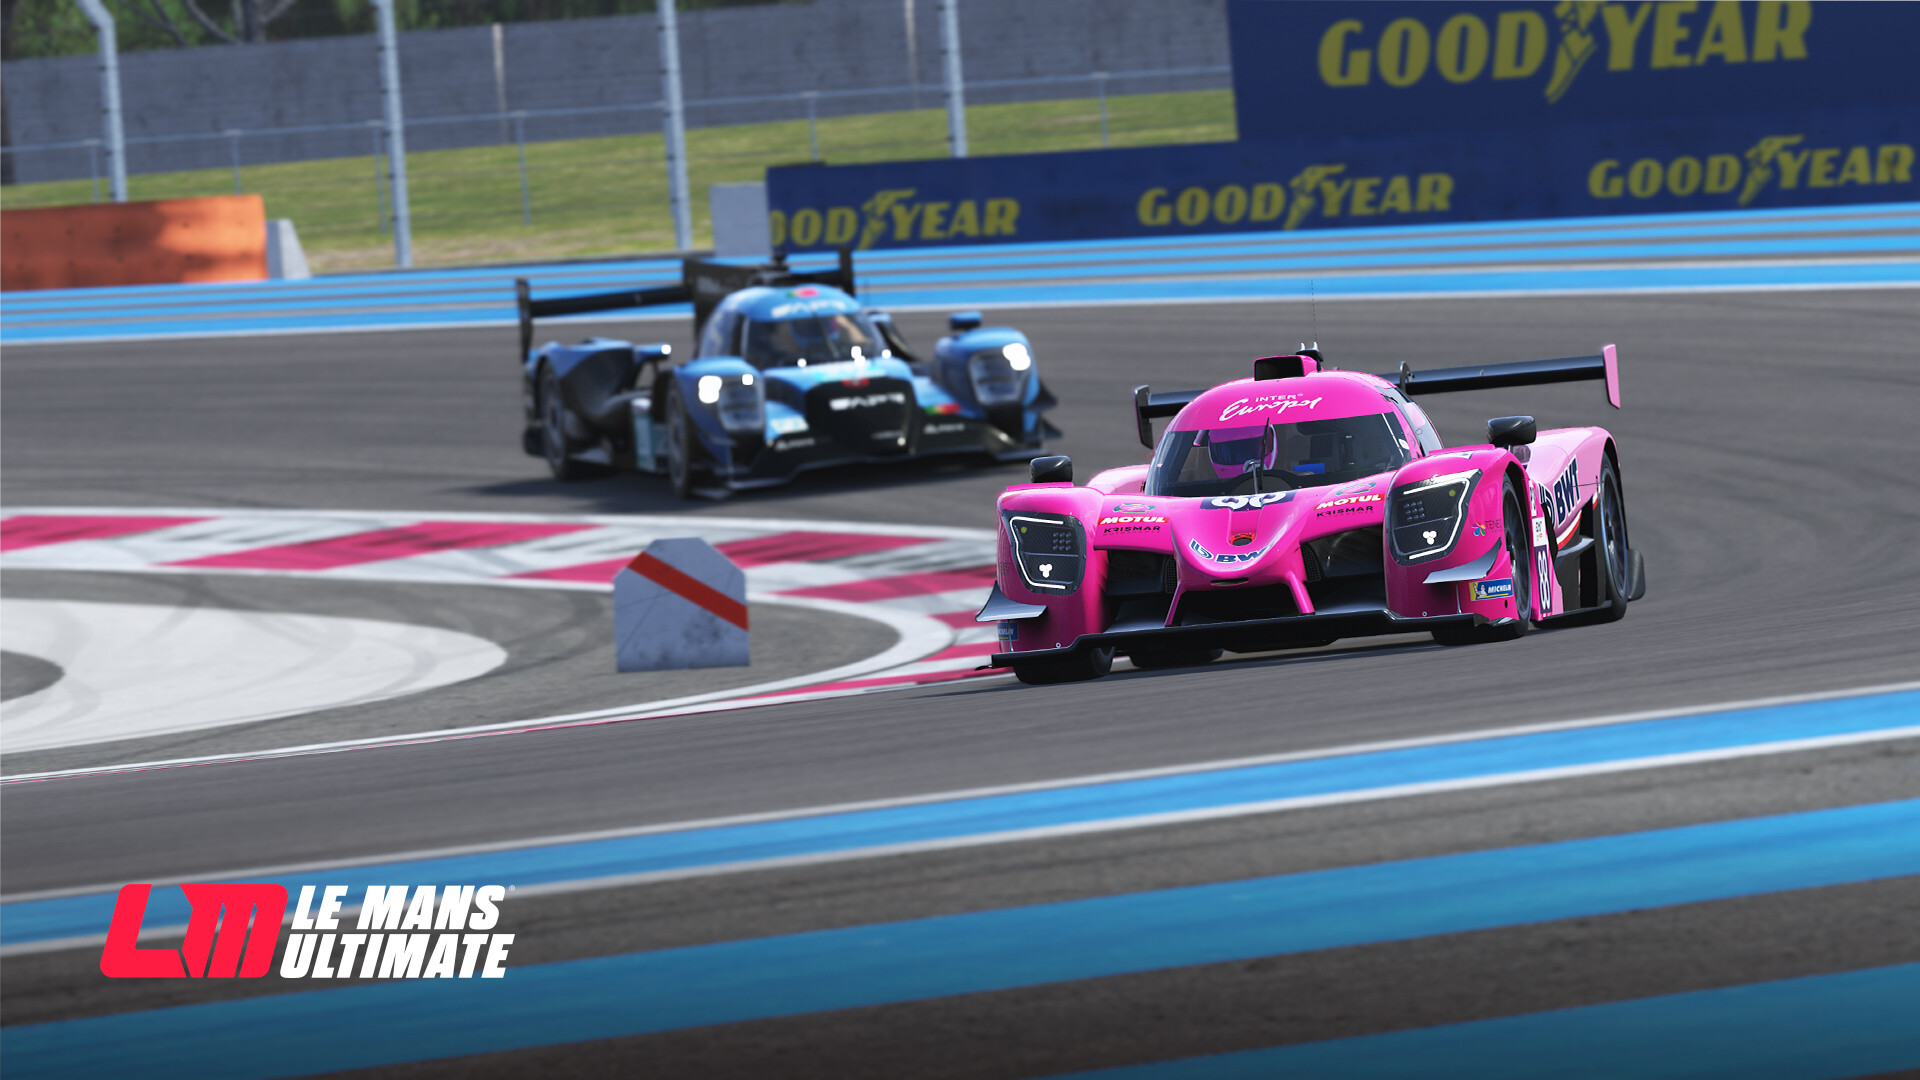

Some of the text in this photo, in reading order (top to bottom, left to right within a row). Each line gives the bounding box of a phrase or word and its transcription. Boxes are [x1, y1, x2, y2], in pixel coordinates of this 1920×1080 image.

[1255, 394, 1297, 402] INTER
[1219, 397, 1323, 422] Europol
[1553, 455, 1581, 528] BWT
[1316, 494, 1382, 510] MOTUL
[1099, 516, 1166, 525] MOTUL
